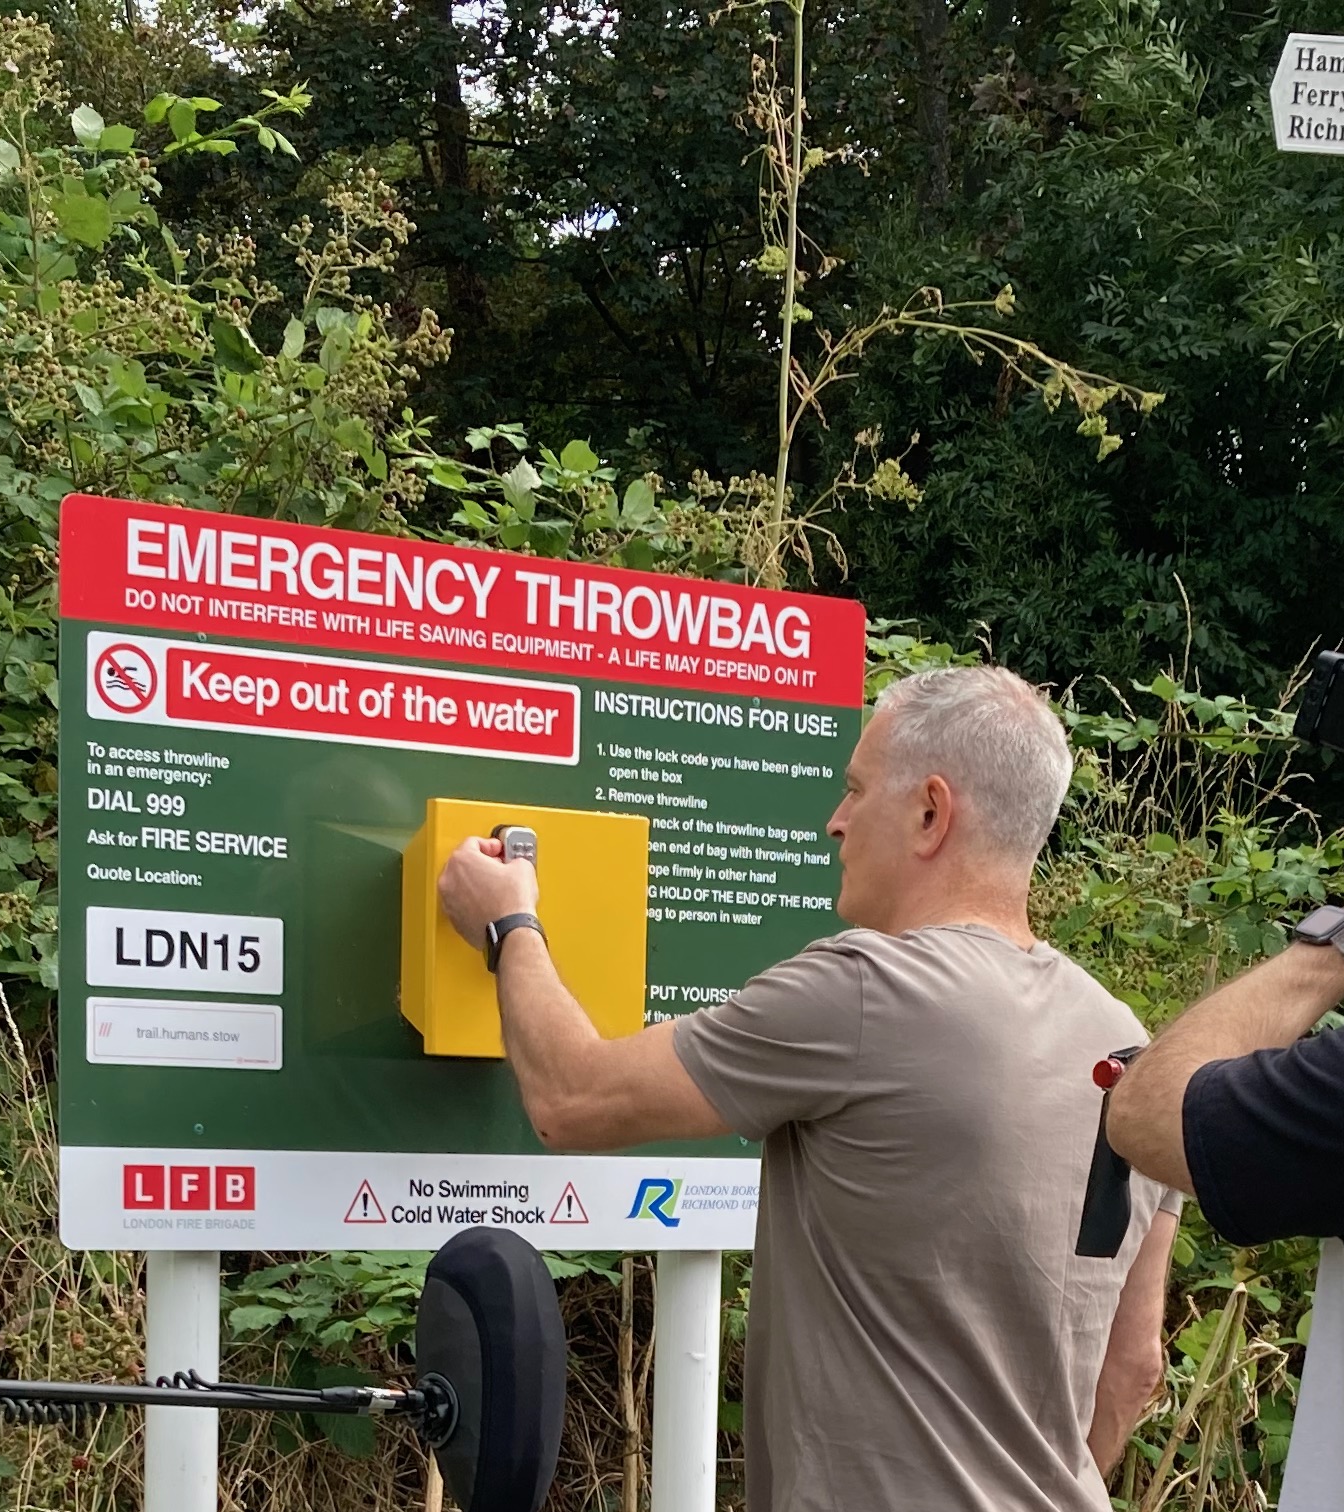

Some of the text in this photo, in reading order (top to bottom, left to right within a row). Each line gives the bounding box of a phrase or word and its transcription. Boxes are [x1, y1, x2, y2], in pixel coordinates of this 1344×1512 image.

[127, 518, 812, 659] EMERGENCY THROWBAG
[125, 587, 156, 609] DO
[161, 592, 204, 615] NOT
[208, 597, 317, 629] INTERFERE
[322, 611, 370, 635] WITH
[375, 618, 415, 640] LIFE
[419, 623, 487, 649] SAVING
[492, 634, 594, 662] EQUIPMENT
[607, 647, 621, 665] A
[624, 650, 661, 670] LIFE
[664, 653, 701, 674] MAY
[704, 658, 770, 684] DEPEND
[774, 665, 800, 686] ON
[802, 669, 817, 688] IT
[181, 659, 559, 736] Keep out of the water
[594, 690, 838, 738] INSTRUCTIONS FOR USE:
[86, 741, 230, 770] To access throwline
[597, 743, 833, 779] 1. Use the lock code you have been given to
[87, 759, 212, 787] in an emergency:
[609, 767, 683, 784] open the box
[87, 787, 186, 817] DIAL 999
[595, 787, 708, 810] 2. Remove throwline
[652, 817, 818, 843] neck of the throwline bag open
[87, 827, 288, 859] Ask for FIRE SERVICE
[669, 842, 690, 855] end
[693, 843, 705, 856] of
[706, 844, 728, 861] bag
[729, 846, 753, 860] with
[755, 848, 802, 867] throwing
[803, 853, 830, 866] hand
[87, 864, 202, 886] Quote Location:
[648, 864, 777, 884] ope firmly in other hand
[659, 885, 692, 902] HOLD
[694, 888, 709, 902] OF
[711, 889, 734, 904] THE
[736, 891, 759, 906] END
[761, 894, 777, 908] OF
[778, 895, 801, 909] THE
[802, 896, 832, 910] ROPE
[647, 907, 762, 926] ag to person in water
[116, 927, 261, 973] LDN15
[650, 985, 741, 1003] PUT YOURS
[654, 1010, 671, 1023] the
[136, 1027, 240, 1043] trail.humans.stow
[409, 1179, 529, 1202] No Swimming
[684, 1185, 760, 1196] LONDON BORO
[391, 1206, 545, 1224] Cold Water Shock
[681, 1199, 738, 1210] RICHMOND
[123, 1219, 255, 1230] LONDON FIRE BRIGADE
